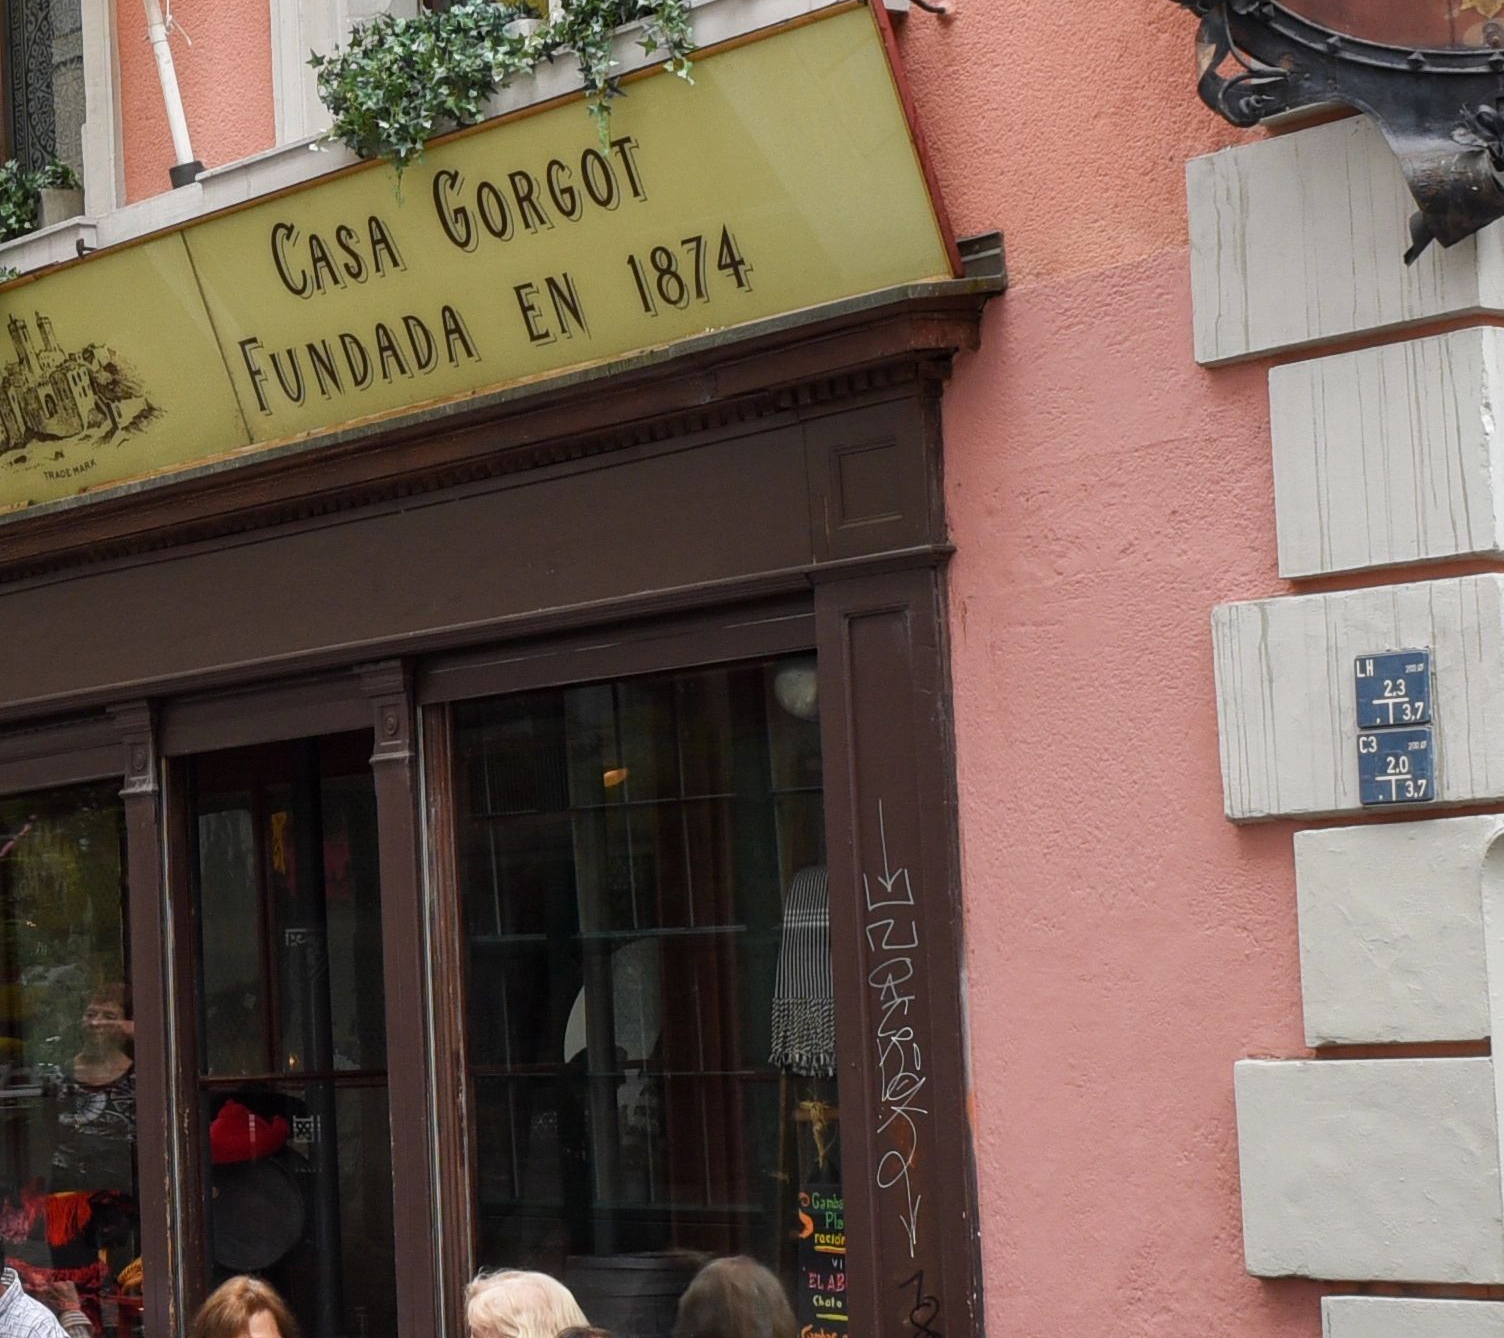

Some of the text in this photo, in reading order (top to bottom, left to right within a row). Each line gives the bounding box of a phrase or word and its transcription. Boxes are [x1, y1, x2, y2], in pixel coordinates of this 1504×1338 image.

[514, 271, 590, 347] EN
[626, 224, 752, 317] 1874
[43, 459, 96, 480] TRADE MARK
[1356, 659, 1373, 678] LH
[1359, 736, 1377, 753] C3
